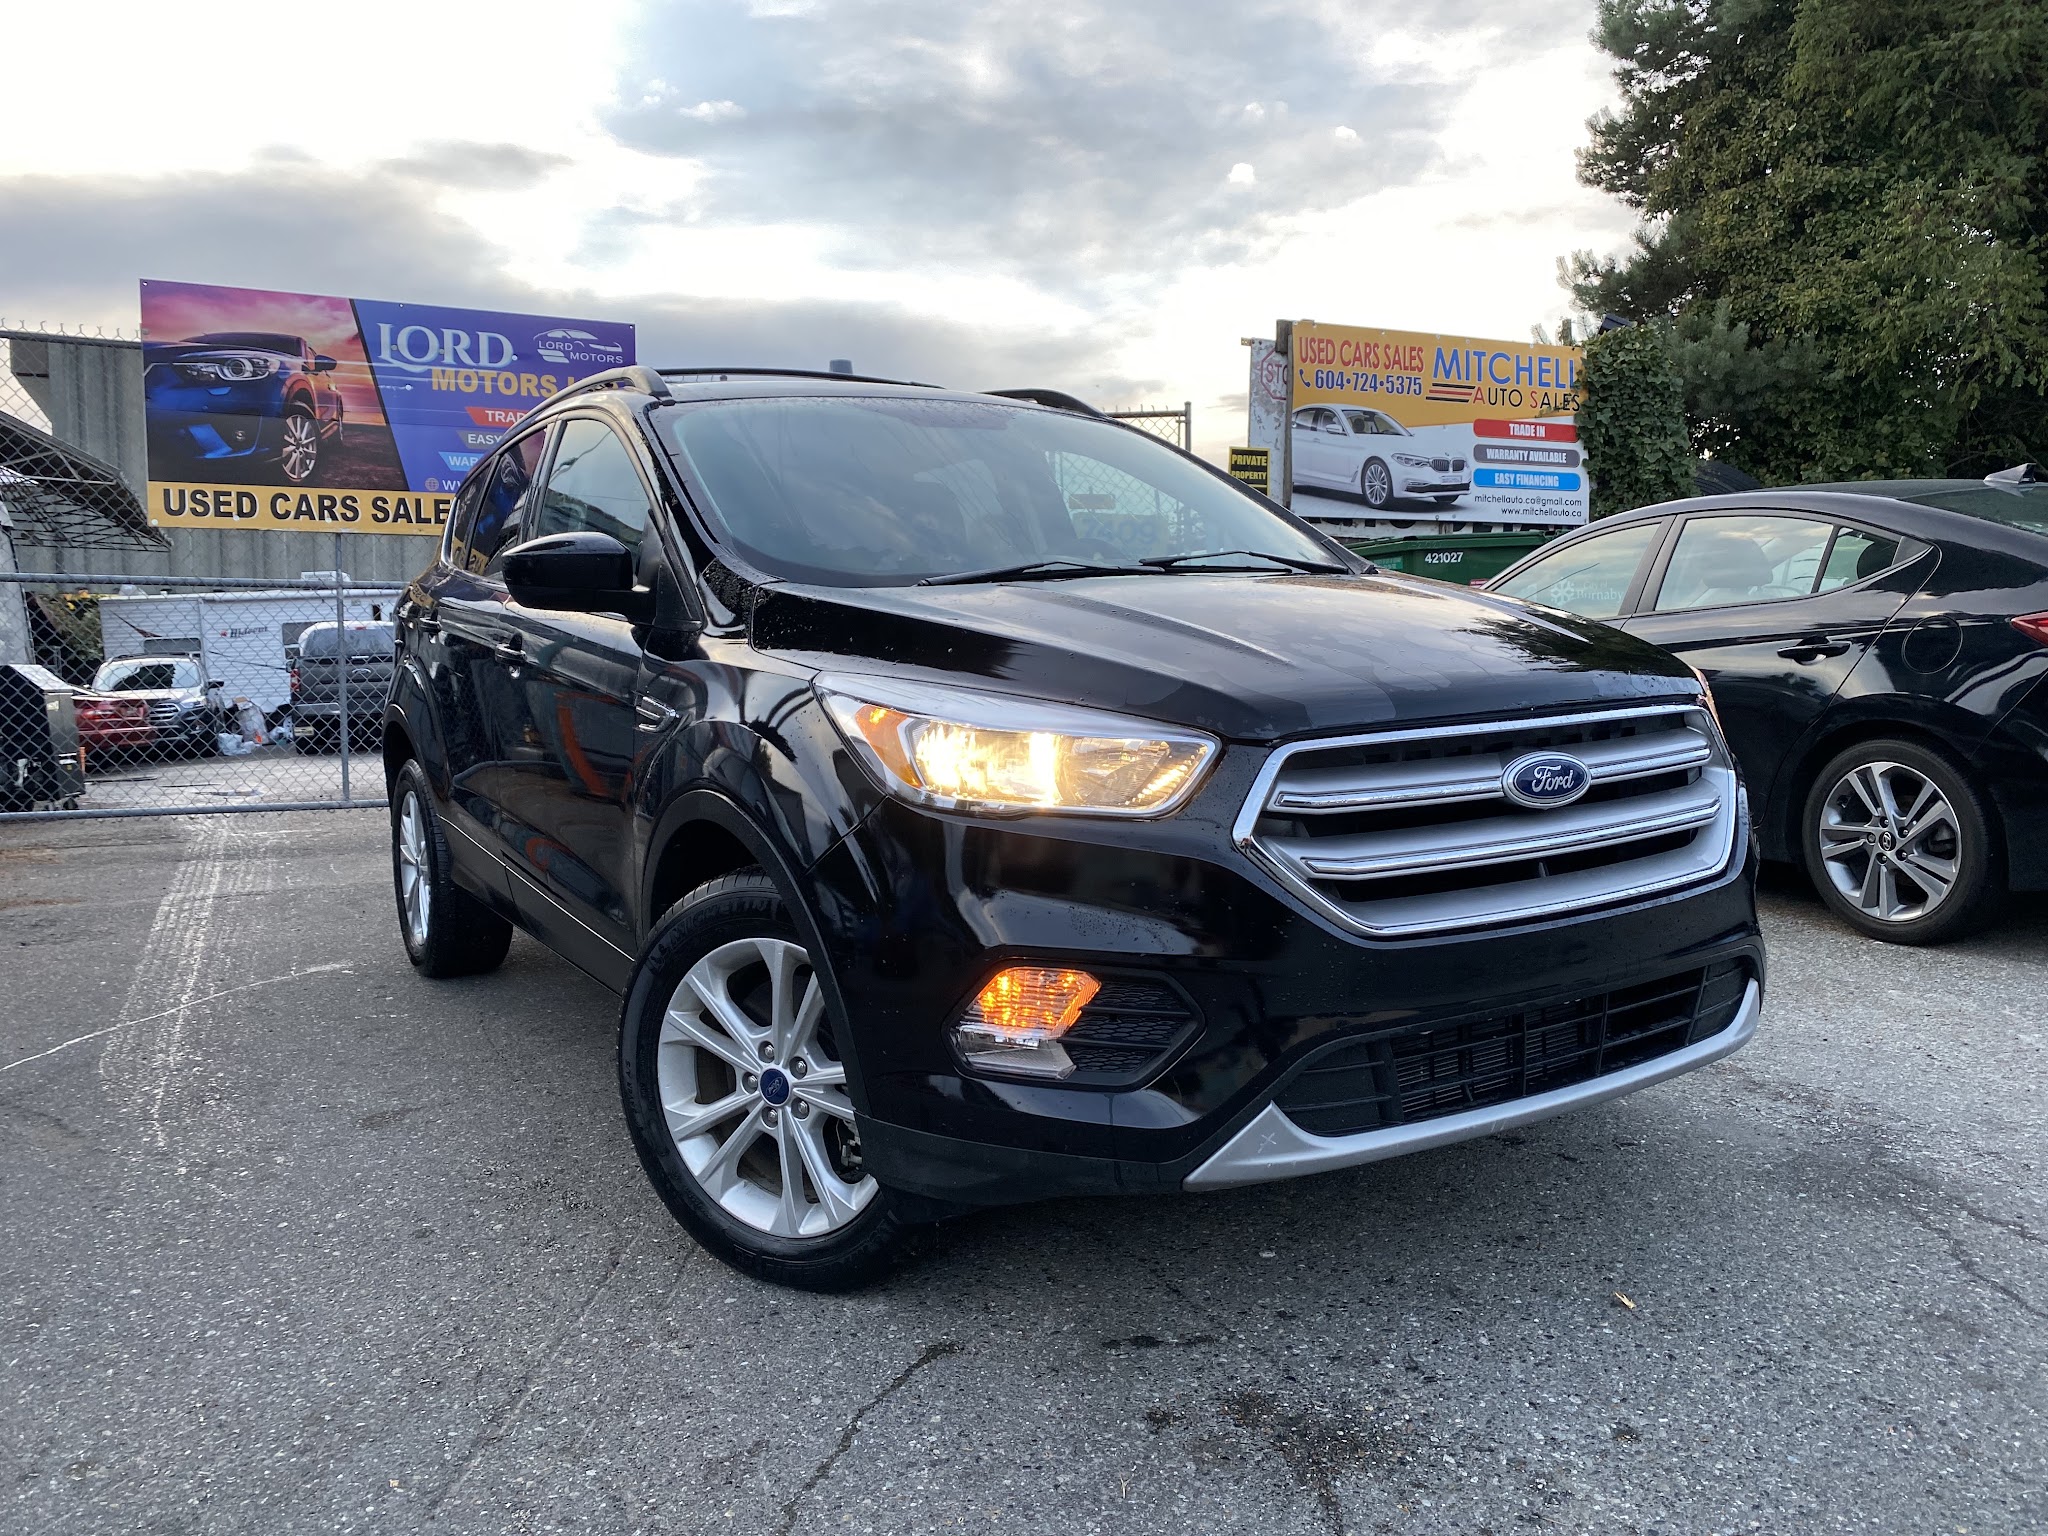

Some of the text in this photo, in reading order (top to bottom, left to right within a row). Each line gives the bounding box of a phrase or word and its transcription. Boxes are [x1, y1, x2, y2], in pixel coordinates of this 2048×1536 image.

[377, 323, 514, 373] LORD
[538, 340, 573, 351] LORD
[570, 351, 623, 364] MOTORS
[1299, 336, 1425, 373] USED CARS SALES
[431, 366, 558, 398] MOTORS
[1473, 386, 1580, 412] AUTO SALES
[1509, 423, 1545, 437] TRADE IN
[467, 433, 503, 445] EASY
[1231, 455, 1267, 466] PRIVATE
[1486, 448, 1567, 463] WARRANTY AVAILABLE
[1231, 471, 1267, 480] PROPERTY
[1494, 473, 1559, 487] EASY FINANCING
[163, 488, 257, 519] USED
[270, 492, 360, 522] CARS
[1474, 494, 1582, 507] mitchellauto.ca@gmail.com
[1501, 506, 1582, 518] www.mitchellauto.ca
[1424, 552, 1463, 564] 421027
[1576, 588, 1624, 602] Burnaby
[1531, 765, 1574, 792] Ford
